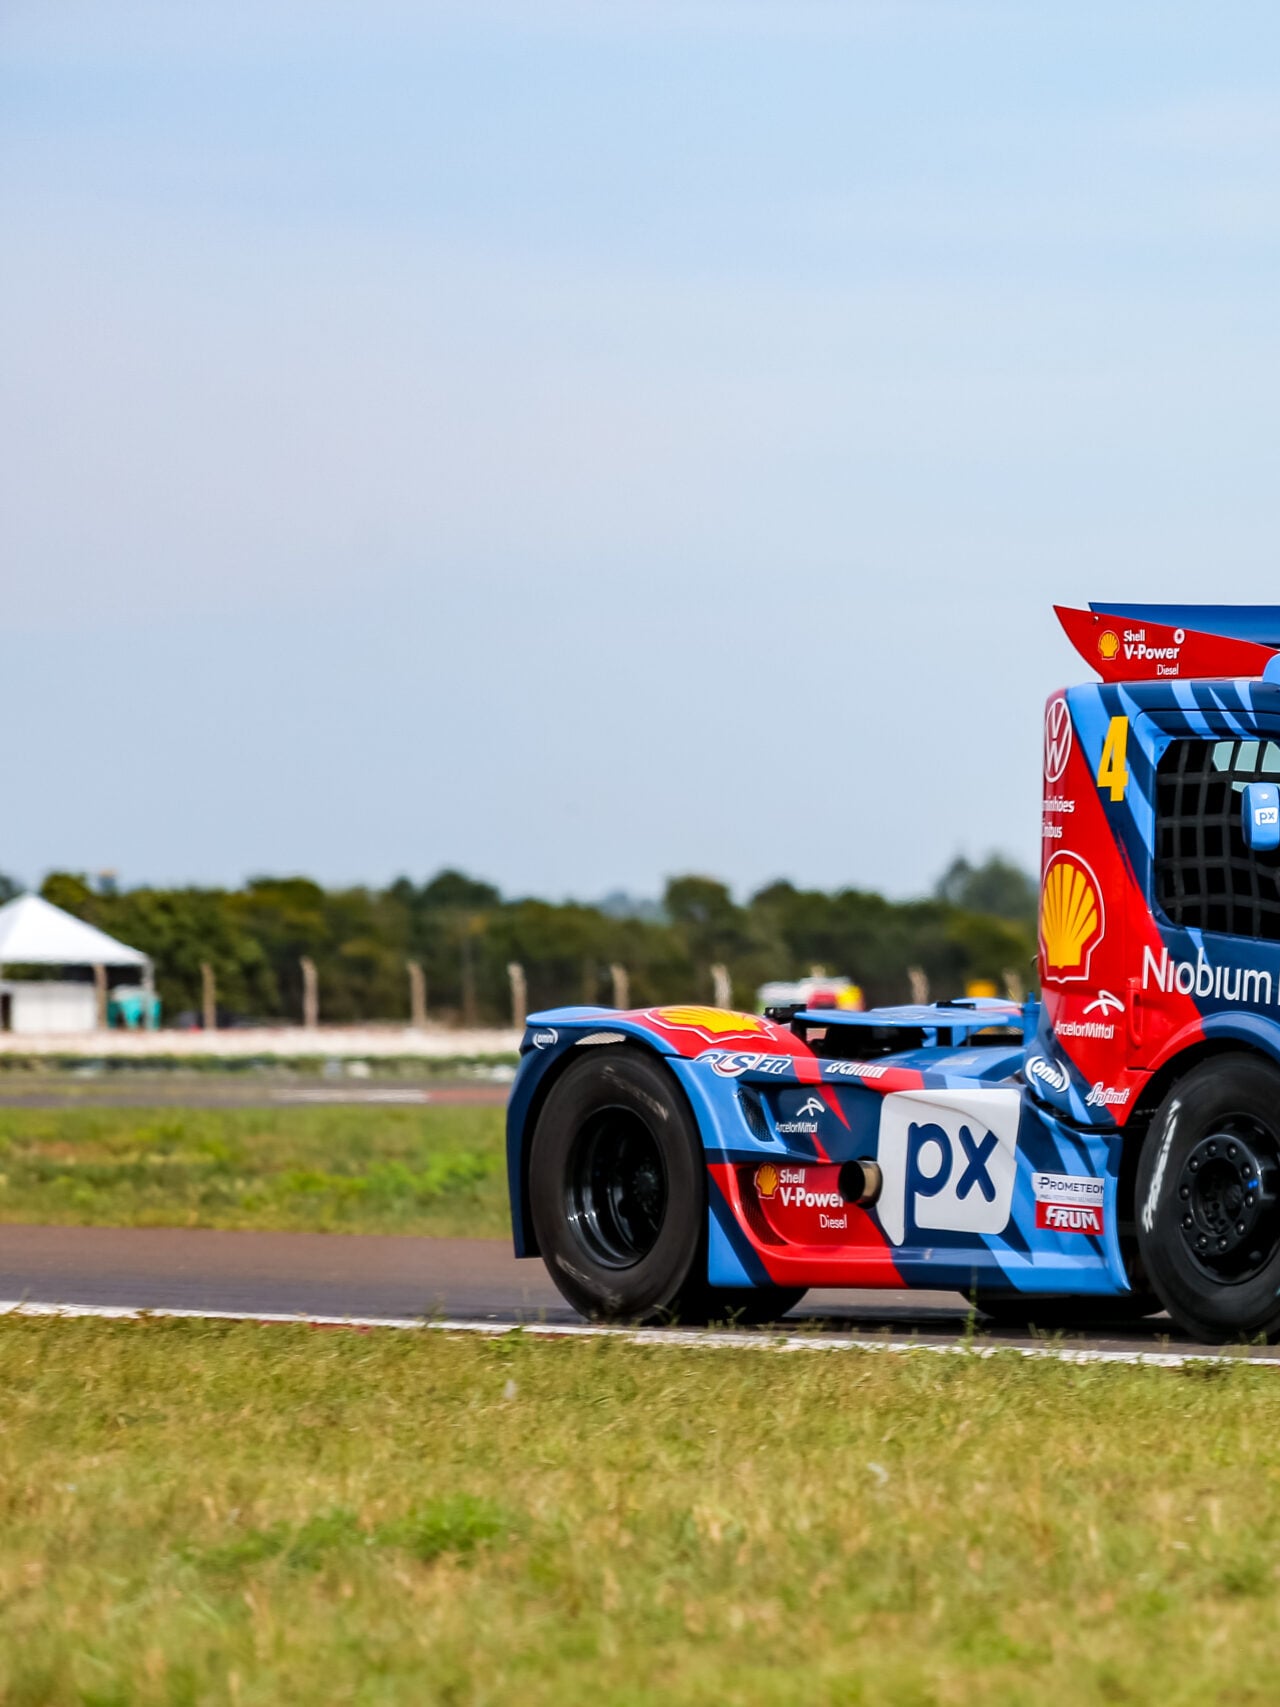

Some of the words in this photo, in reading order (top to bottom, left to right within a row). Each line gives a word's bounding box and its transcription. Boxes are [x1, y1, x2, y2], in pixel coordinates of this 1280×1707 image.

[1123, 629, 1145, 641] Shell
[1123, 644, 1180, 660] V-Power
[1156, 662, 1179, 676] Diesel
[1097, 716, 1129, 802] 4
[1260, 812, 1275, 825] px
[1141, 945, 1272, 1005] Niobium
[1054, 1019, 1115, 1040] ArcelorMittal
[1032, 1061, 1064, 1089] omni
[775, 1121, 818, 1133] ArcelorMittal
[780, 1168, 806, 1184] Shell
[907, 1122, 999, 1236] px
[780, 1187, 844, 1208] V-Power
[819, 1213, 848, 1229] Diesel
[1045, 1205, 1100, 1231] FRUM
